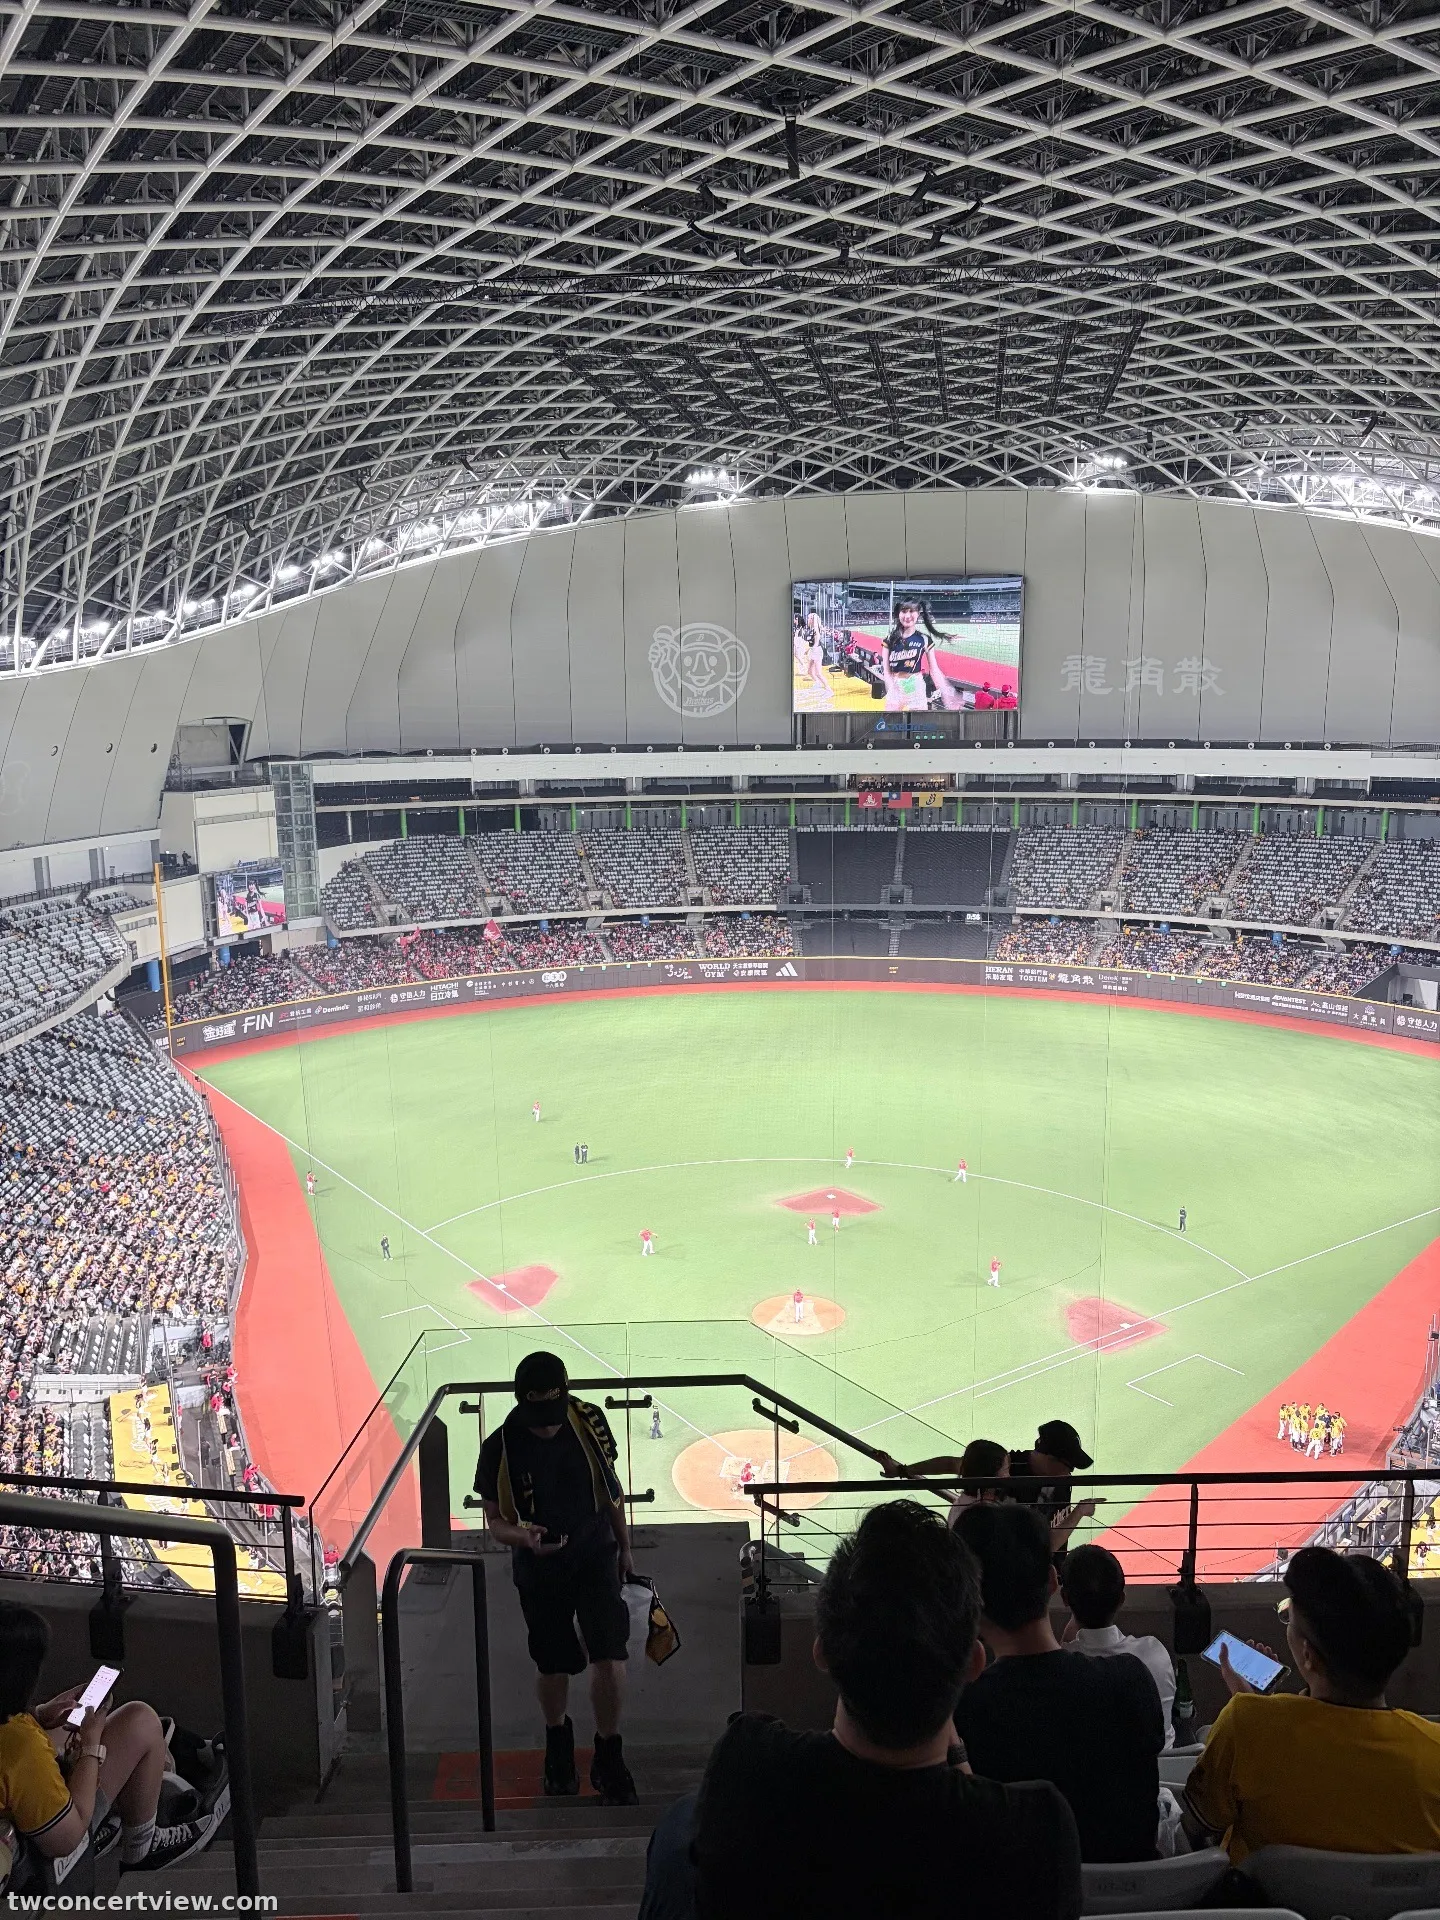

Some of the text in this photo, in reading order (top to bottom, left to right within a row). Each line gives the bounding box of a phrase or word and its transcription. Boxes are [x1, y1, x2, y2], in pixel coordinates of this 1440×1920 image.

[1060, 655, 1227, 696] 龍角散
[985, 966, 1014, 974] HERAN
[1018, 975, 1048, 983] TOSTEM
[430, 982, 459, 991] HITACHI
[242, 1011, 274, 1034] FIN
